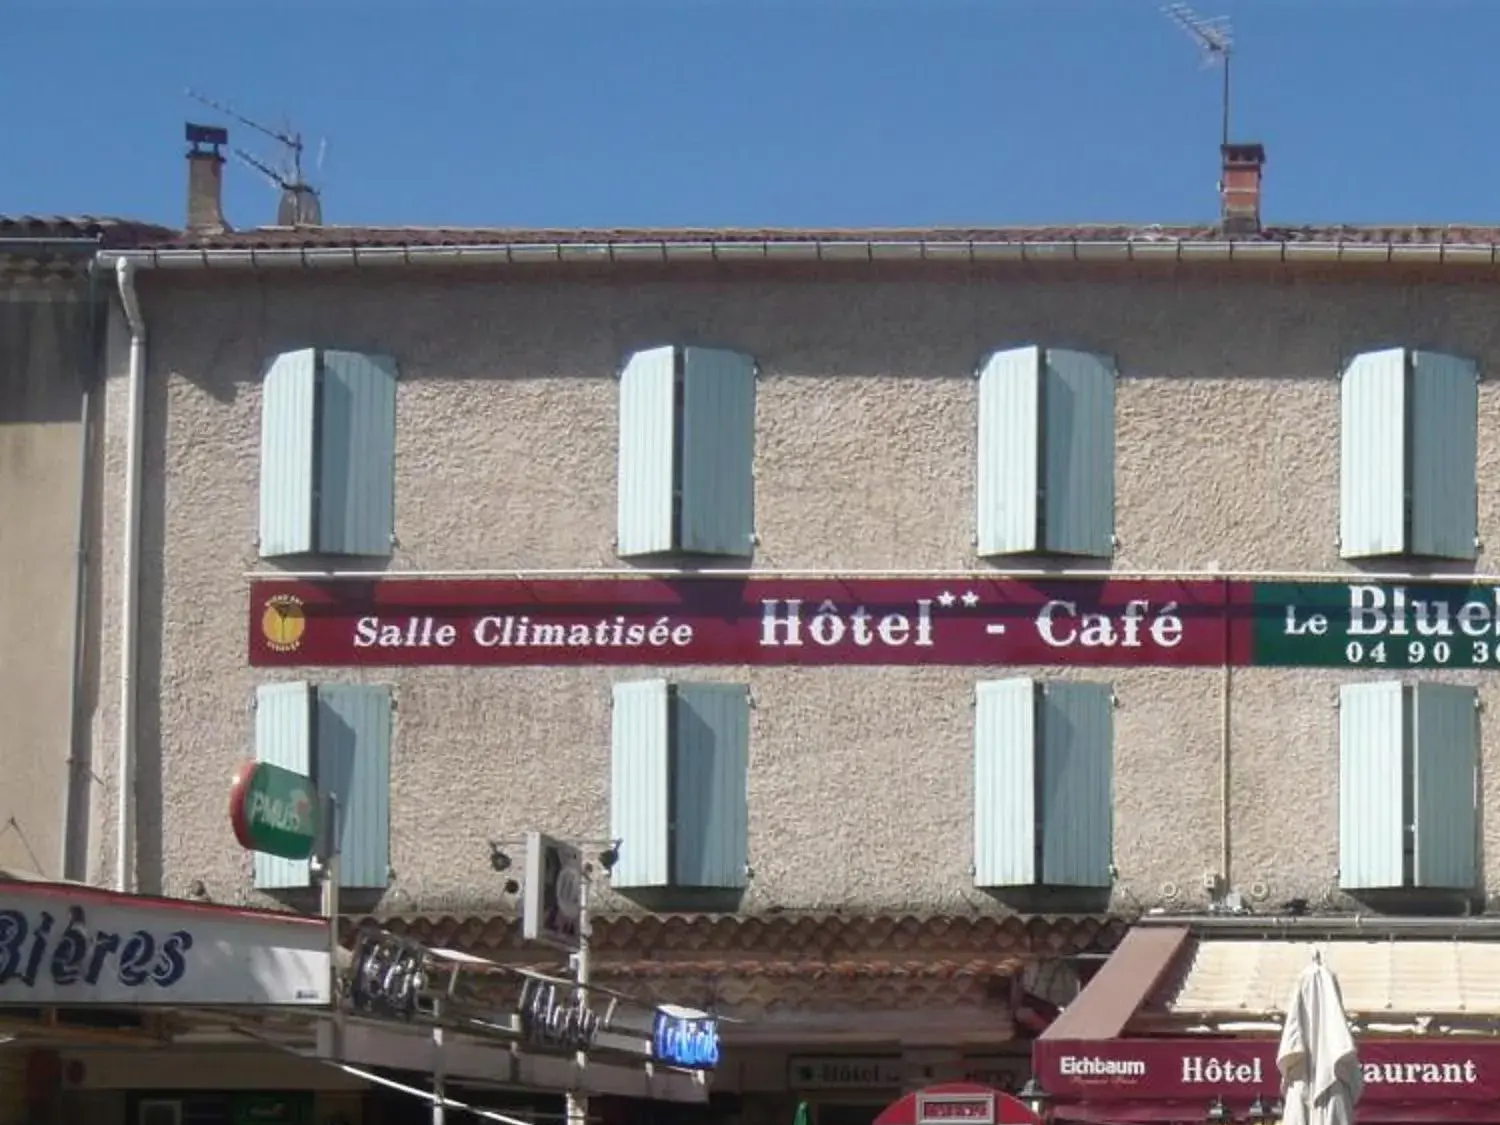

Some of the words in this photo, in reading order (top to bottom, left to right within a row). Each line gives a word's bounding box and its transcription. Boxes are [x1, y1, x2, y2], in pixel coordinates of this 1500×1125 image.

[354, 616, 456, 647] Salle
[473, 616, 694, 646] Climatisée
[1035, 600, 1184, 647] Café
[1284, 605, 1327, 635] Le
[1346, 641, 1387, 664] 04
[1408, 641, 1451, 664] 90
[1060, 1056, 1145, 1076] Eichbaum
[1181, 1056, 1263, 1084] Hôtel
